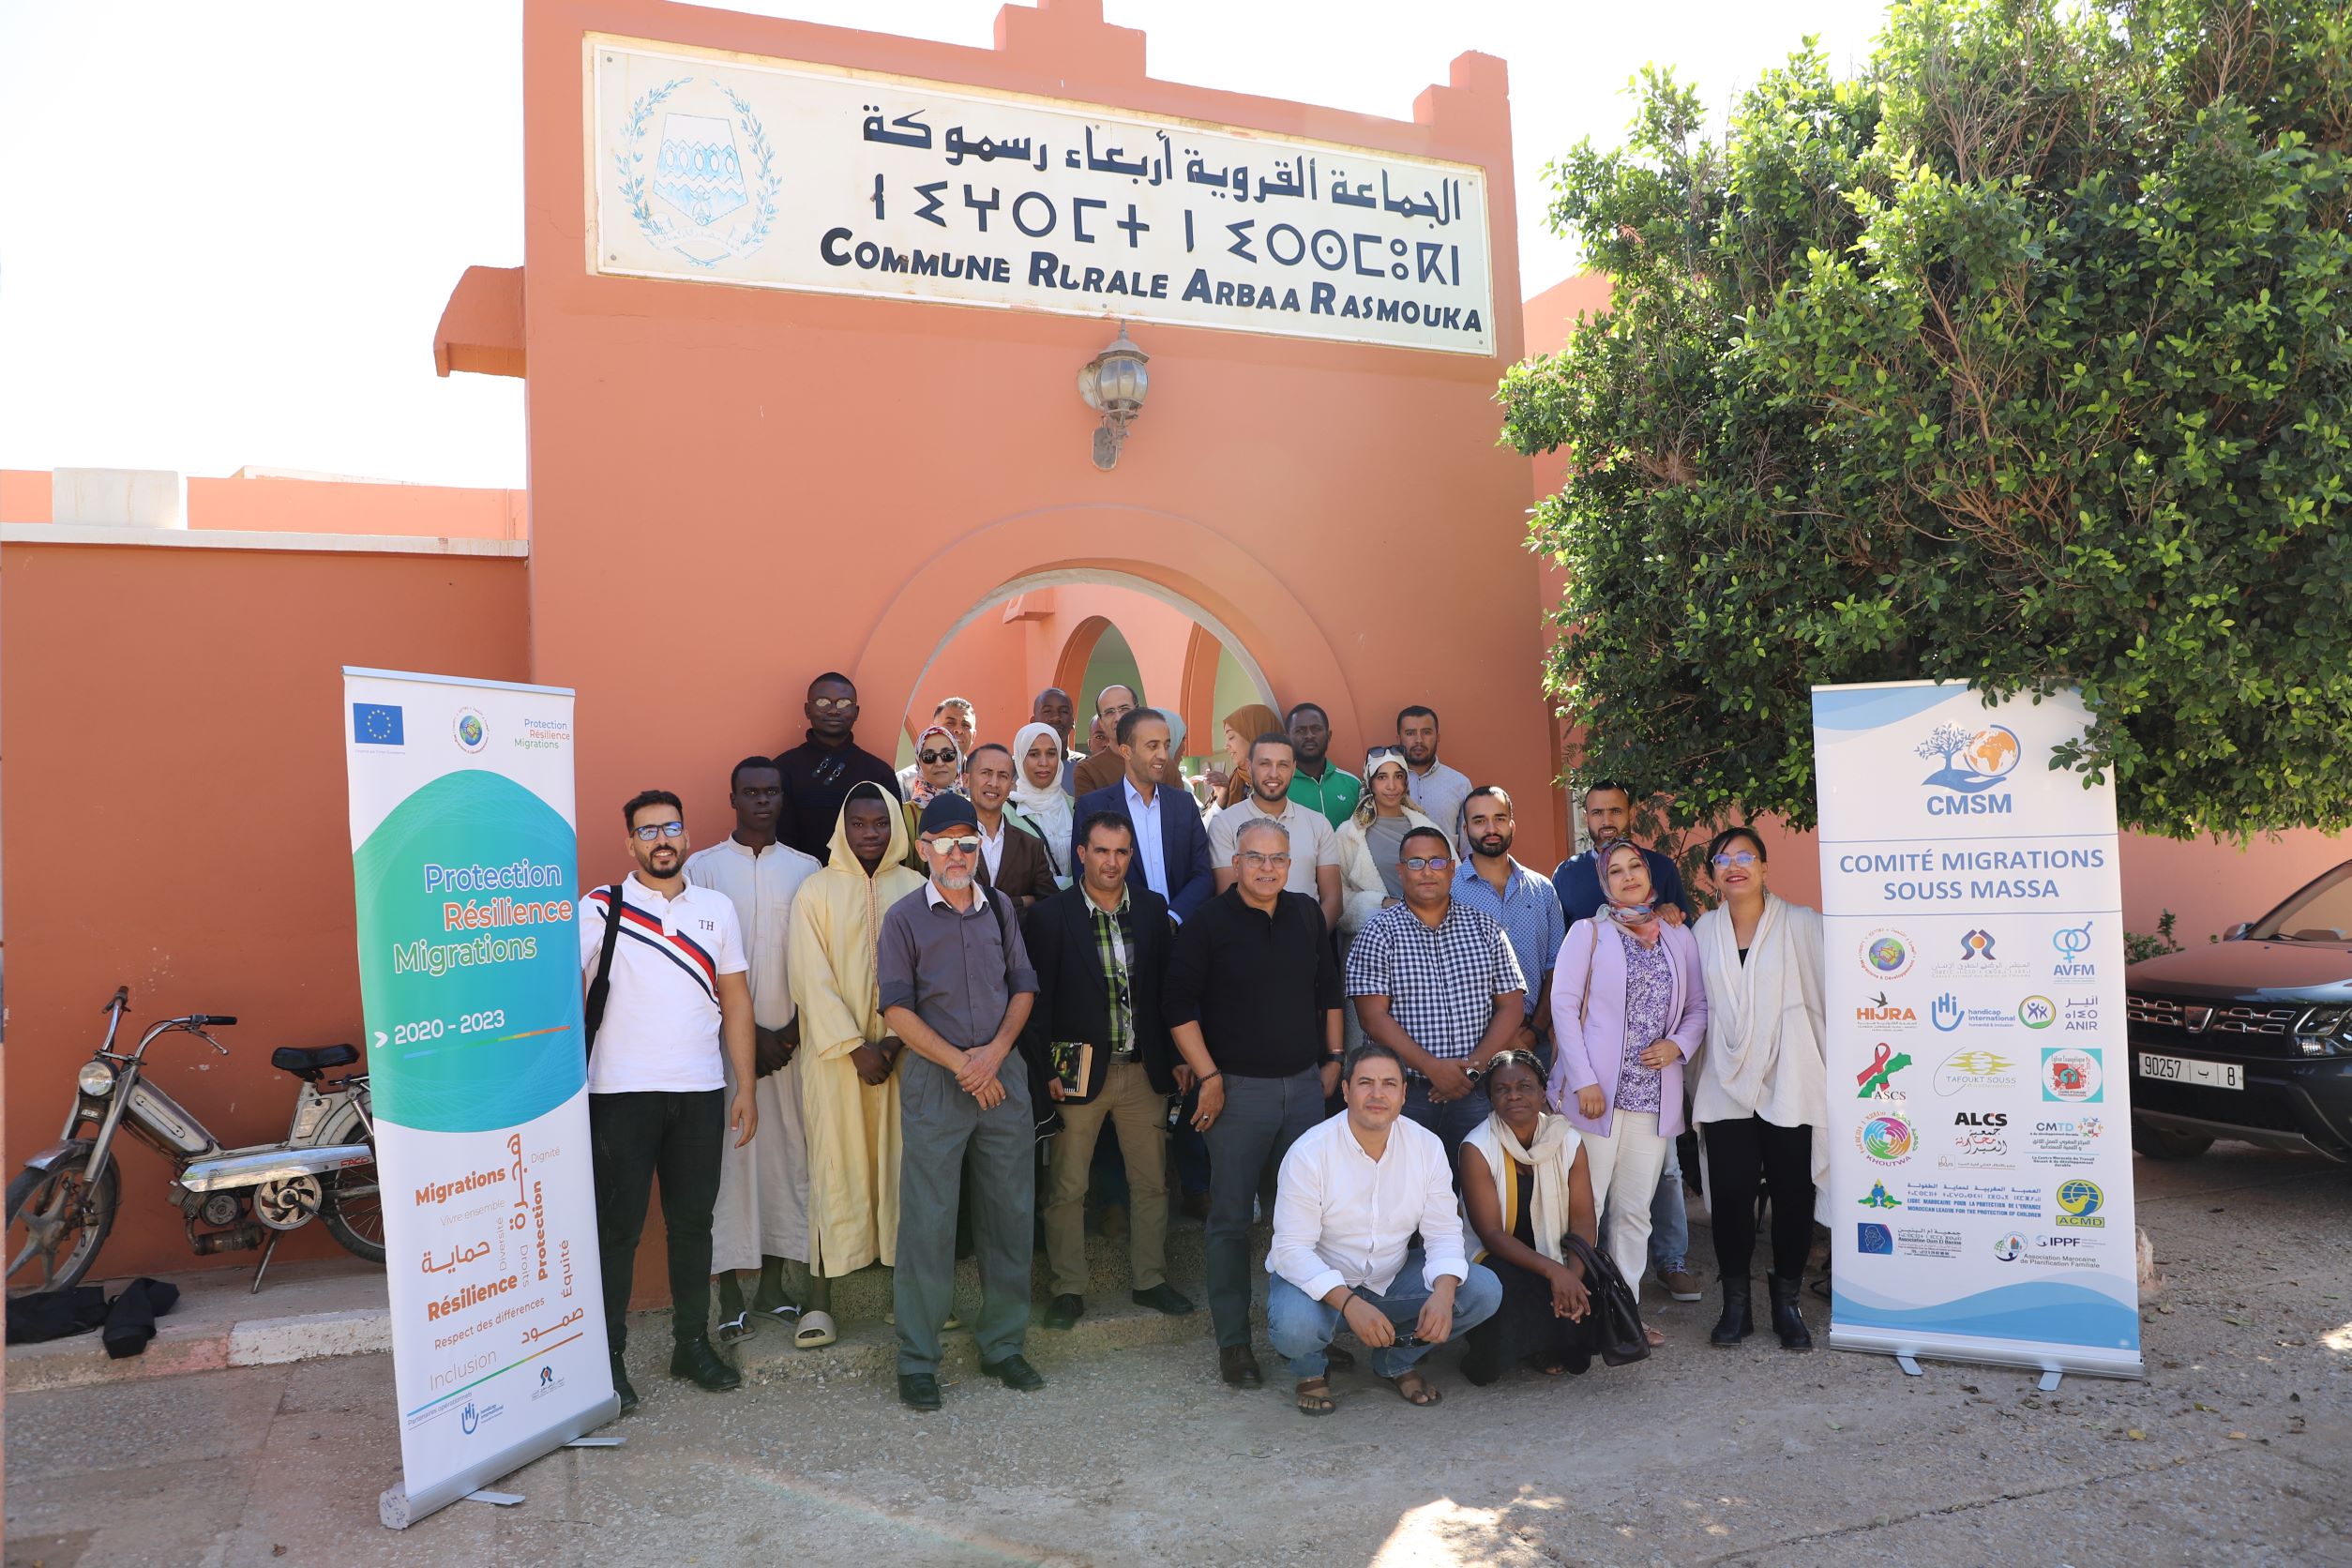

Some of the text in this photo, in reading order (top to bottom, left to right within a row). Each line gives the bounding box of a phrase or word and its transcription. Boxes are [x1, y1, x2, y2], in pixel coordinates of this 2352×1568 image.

[863, 104, 1461, 231] الجماعة القروية أربعاء رسموكة
[821, 227, 1011, 283] COMMUNE
[1182, 268, 1301, 312] ARBAA
[1310, 282, 1483, 333] RASMOUKA
[524, 718, 567, 730] Protection
[529, 729, 570, 741] Résilience
[514, 738, 560, 750] Migrations
[1926, 793, 2013, 816] CMSM
[1839, 849, 2105, 873] COMITÉ MIGRATIONS
[424, 858, 563, 893] Protection
[1883, 879, 2060, 900] SOUSS MASSA
[443, 897, 573, 931] Résilience
[698, 919, 715, 931] TH
[393, 933, 537, 976] Migrations
[2053, 964, 2095, 976] AVFM
[1856, 1007, 1917, 1020] HIJRA
[1968, 1009, 2001, 1018] handicap
[394, 1018, 445, 1045] 2020
[460, 1009, 505, 1034] 2023
[2065, 1020, 2098, 1031] ANIR
[2145, 1056, 2181, 1078] 90257
[2227, 1066, 2236, 1086] 8
[1874, 1091, 1907, 1100] ASCS
[1954, 1112, 2008, 1126] ALCS
[2036, 1122, 2074, 1132] CMTD
[531, 1146, 561, 1164] Dignité
[1866, 1154, 1912, 1167] KHOUTWA
[415, 1168, 506, 1206] Migrations
[440, 1199, 505, 1227] Vivre ensemble
[2058, 1216, 2103, 1226] ACMD
[532, 1180, 549, 1281] Protection
[2050, 1237, 2081, 1247] IPPF
[496, 1216, 507, 1272] Diversité
[421, 1241, 490, 1274] حماية
[520, 1244, 530, 1289] Droits
[560, 1239, 573, 1298] Équité
[2024, 1253, 2061, 1261] Association
[2029, 1259, 2070, 1267] Planification
[427, 1274, 518, 1321] Résilience
[434, 1297, 545, 1350] Respect des différences
[521, 1307, 584, 1344] صمود
[430, 1349, 497, 1392] Inclusion
